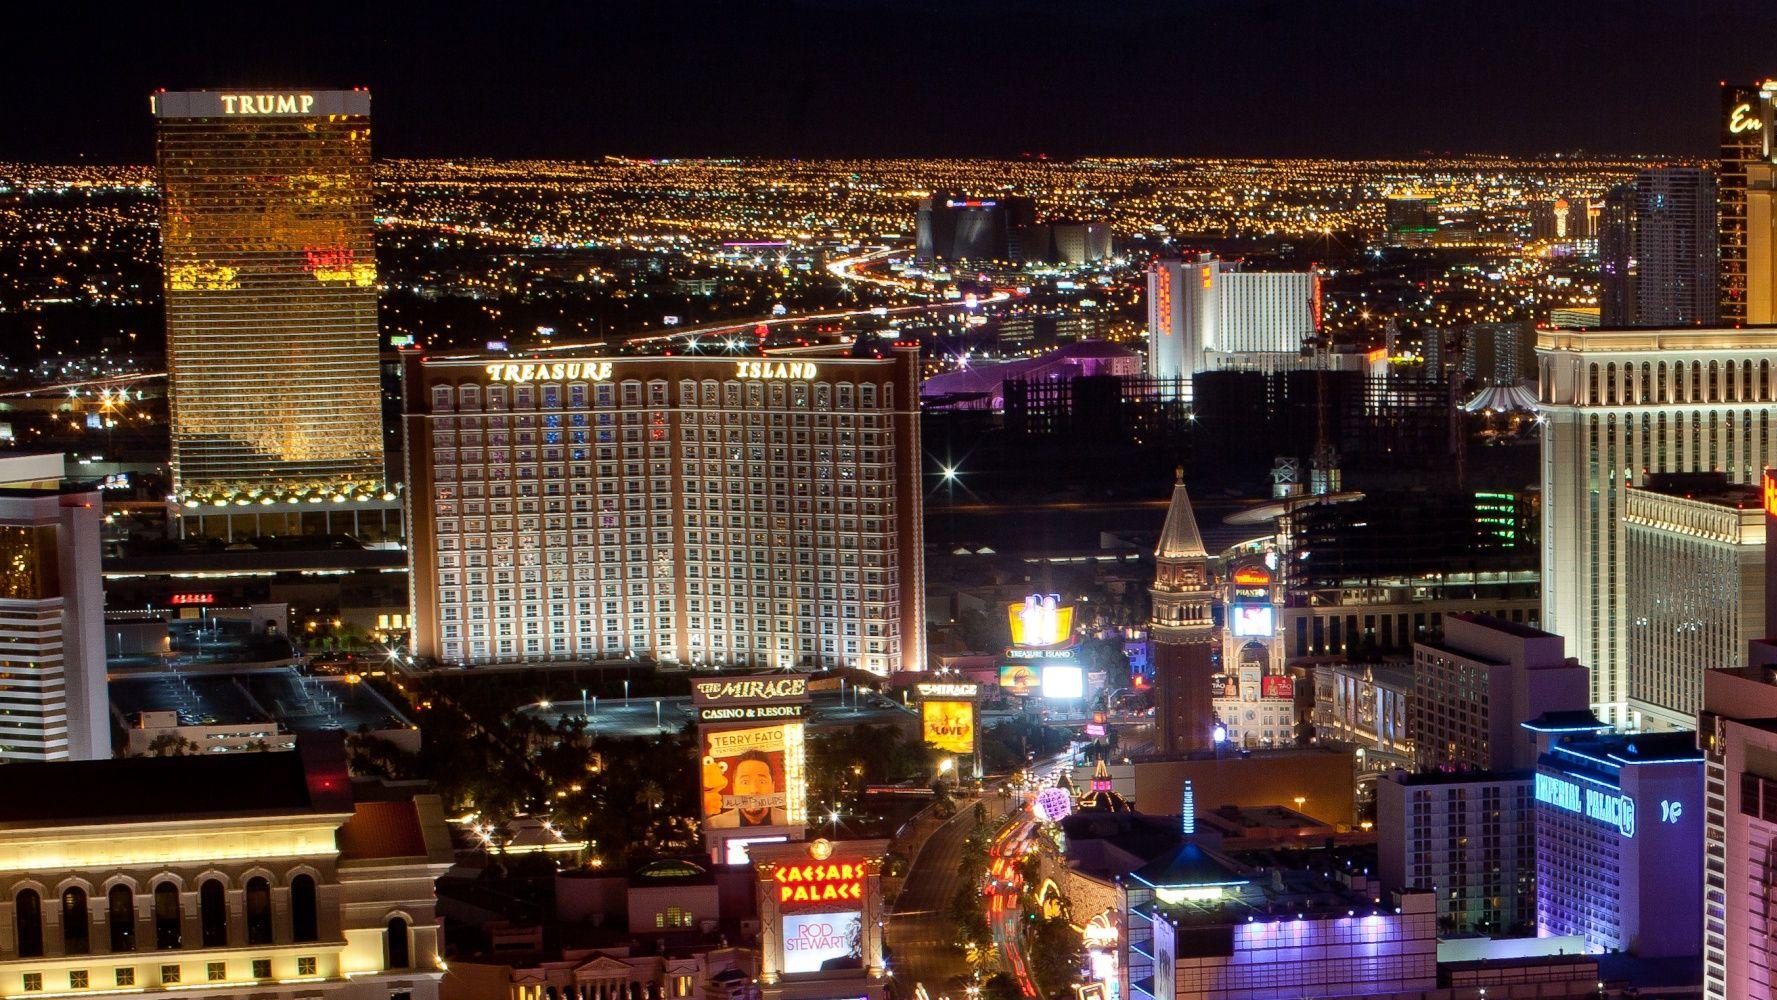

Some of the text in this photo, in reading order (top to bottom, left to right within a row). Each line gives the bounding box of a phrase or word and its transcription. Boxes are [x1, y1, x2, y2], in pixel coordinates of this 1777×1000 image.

[221, 95, 314, 114] TRUMP
[486, 362, 817, 382] TREASURE ISLAND
[1045, 650, 1071, 658] ISLAND
[721, 680, 805, 698] MIRAGE
[702, 706, 802, 719] CASINO & RESORT
[714, 730, 783, 746] TERRY FATO
[935, 726, 962, 736] LOVE
[1535, 773, 1581, 813] IMPERIAL
[775, 864, 864, 883] CAESARS
[781, 883, 861, 902] PALACE
[798, 924, 833, 938] ROD
[786, 936, 845, 951] STEWART
